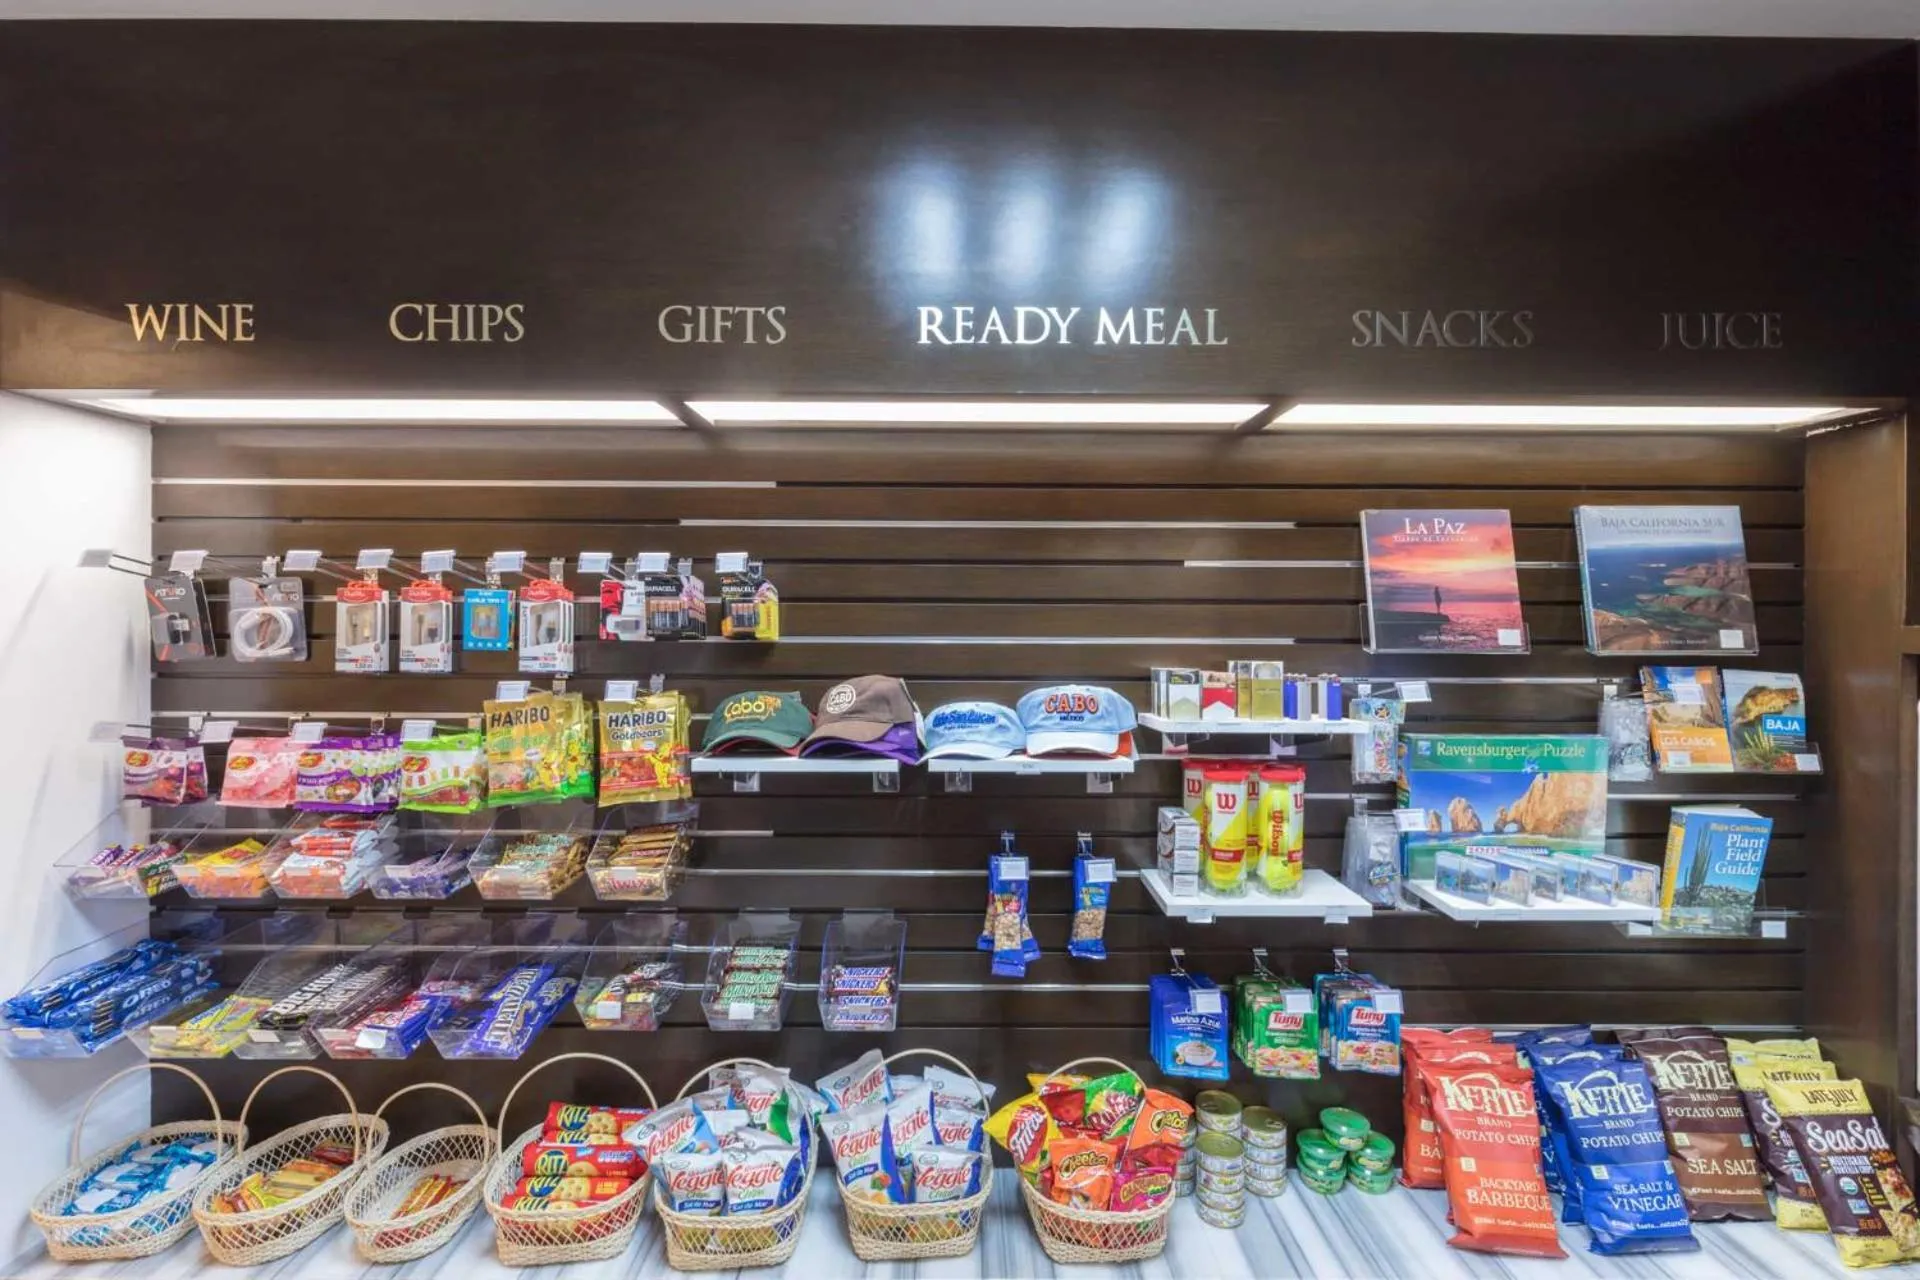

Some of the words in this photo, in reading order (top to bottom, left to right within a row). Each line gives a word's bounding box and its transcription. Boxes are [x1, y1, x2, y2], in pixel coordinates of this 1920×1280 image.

[126, 303, 257, 343] WINE
[389, 303, 526, 344] CHIPS
[658, 305, 787, 346] GIFTS
[918, 306, 1078, 348] READY
[1094, 307, 1228, 347] MEAL
[1349, 309, 1535, 348] SNACKS
[1660, 312, 1784, 352] JUICE
[1045, 693, 1099, 714] CABO
[491, 706, 550, 729] HARIBO
[609, 711, 667, 729] HARIBO
[1766, 719, 1801, 732] BAJA
[1437, 742, 1527, 759] Ravensburger
[1541, 744, 1585, 758] Puzzle
[1727, 833, 1766, 848] Plant
[1725, 848, 1762, 862] Field
[1715, 861, 1759, 876] Guide
[843, 967, 887, 977] SNICKERS
[836, 979, 877, 989] SNICKERS
[843, 997, 889, 1007] SNICKERS
[1171, 1015, 1200, 1024] Marina
[1273, 1012, 1302, 1028] Tuny
[1356, 1008, 1385, 1024] Tuny
[1645, 1056, 1736, 1090] KETTLE
[1436, 1076, 1537, 1118] KETTLE
[1556, 1081, 1656, 1120] KETTLE
[1689, 1093, 1719, 1102] BRAND
[1666, 1105, 1714, 1118] POTATO
[1476, 1116, 1511, 1128] BRAND
[1603, 1118, 1635, 1130] BRAND
[1455, 1129, 1505, 1144] POTATO
[1580, 1136, 1630, 1150] POTATO
[834, 1131, 882, 1161] Veggie
[1059, 1151, 1108, 1179] Cheetos
[1687, 1159, 1722, 1175] SEA
[1726, 1159, 1758, 1176] SALT
[668, 1166, 725, 1192] Veggie
[726, 1162, 784, 1188] Veggie
[916, 1164, 970, 1190] Veggie
[1480, 1177, 1541, 1192] BACKYARD
[1466, 1188, 1553, 1211] BARBEQUE
[1608, 1193, 1684, 1212] VINEGAR
